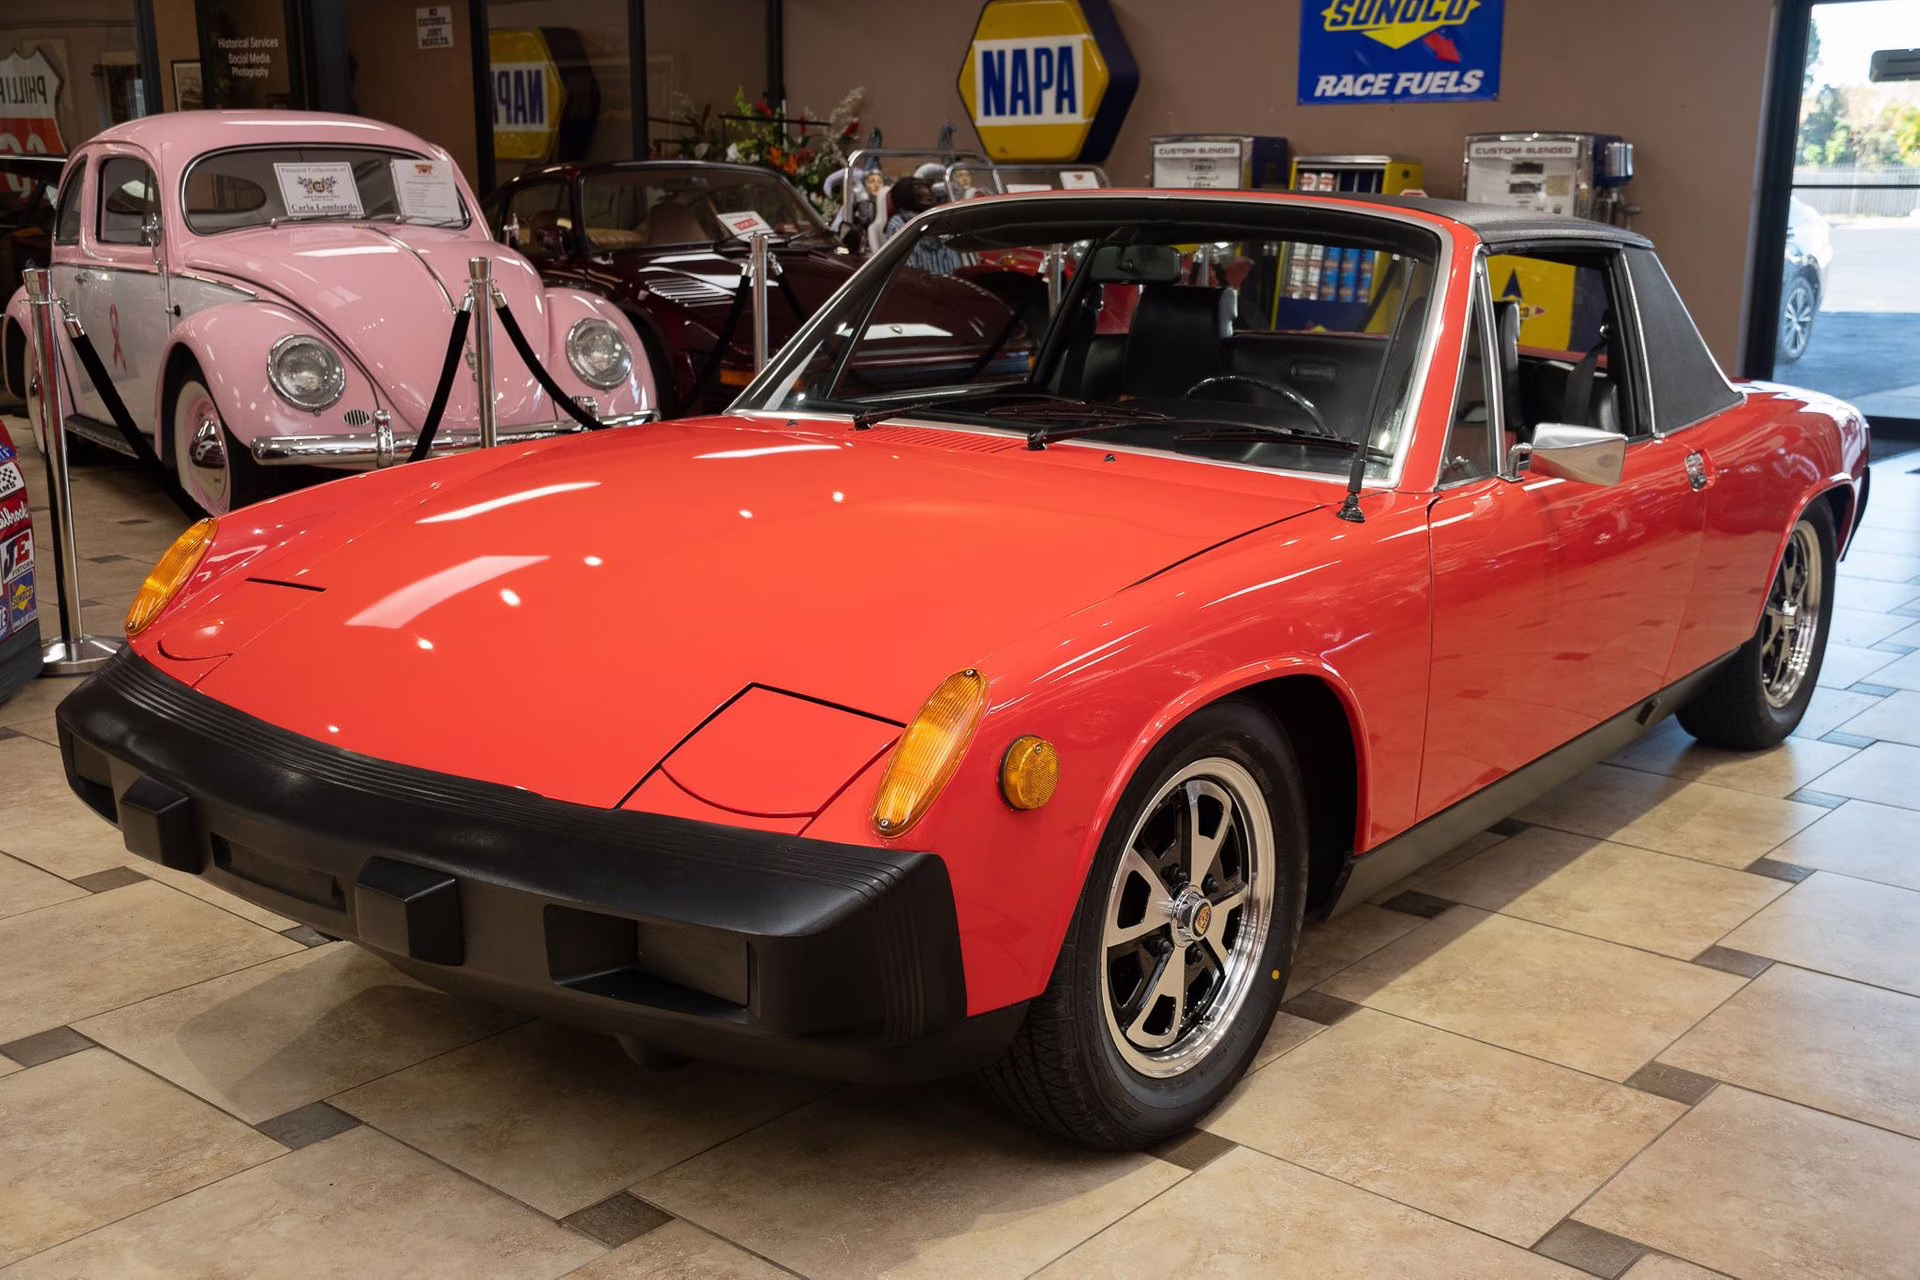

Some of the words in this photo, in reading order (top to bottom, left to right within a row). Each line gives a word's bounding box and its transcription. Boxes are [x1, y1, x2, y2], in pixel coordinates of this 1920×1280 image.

[218, 37, 249, 48] Historical
[250, 36, 279, 48] Services
[228, 53, 249, 64] Social
[249, 52, 270, 64] Media
[231, 66, 269, 79] Photography
[982, 46, 1077, 117] NAPA
[1314, 73, 1394, 97] RACE
[1393, 69, 1484, 95] FUELS
[1158, 146, 1195, 155] CUSTOM
[1197, 146, 1236, 155] BLENDED
[1475, 146, 1521, 155] CUSTOM
[1526, 146, 1573, 154] BLENDED
[316, 203, 358, 211] Lombardo
